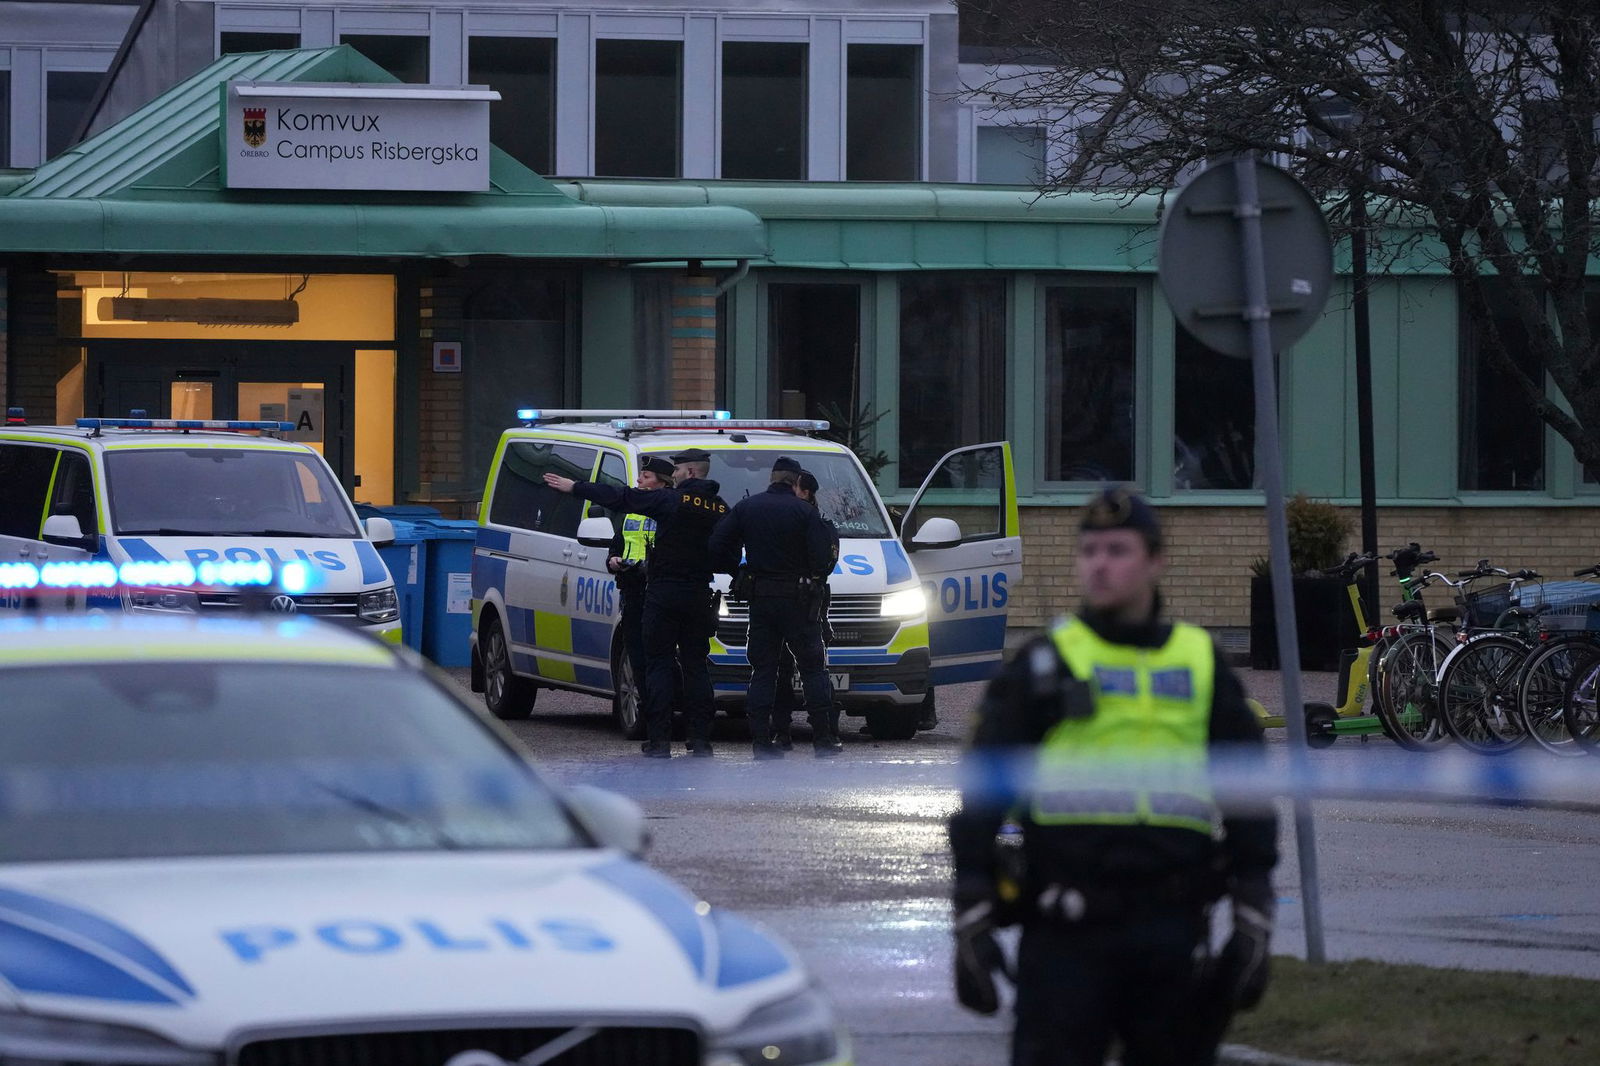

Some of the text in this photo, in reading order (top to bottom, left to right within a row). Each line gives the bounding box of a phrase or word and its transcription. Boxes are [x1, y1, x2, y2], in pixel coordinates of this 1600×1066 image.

[277, 108, 380, 132] Komvux
[240, 149, 269, 158] ÖREBRO
[276, 140, 478, 165] Campus Risbergska
[296, 410, 314, 431] A
[682, 494, 726, 513] POLIS
[576, 576, 615, 617] POLIS
[217, 917, 616, 964] POLIS
